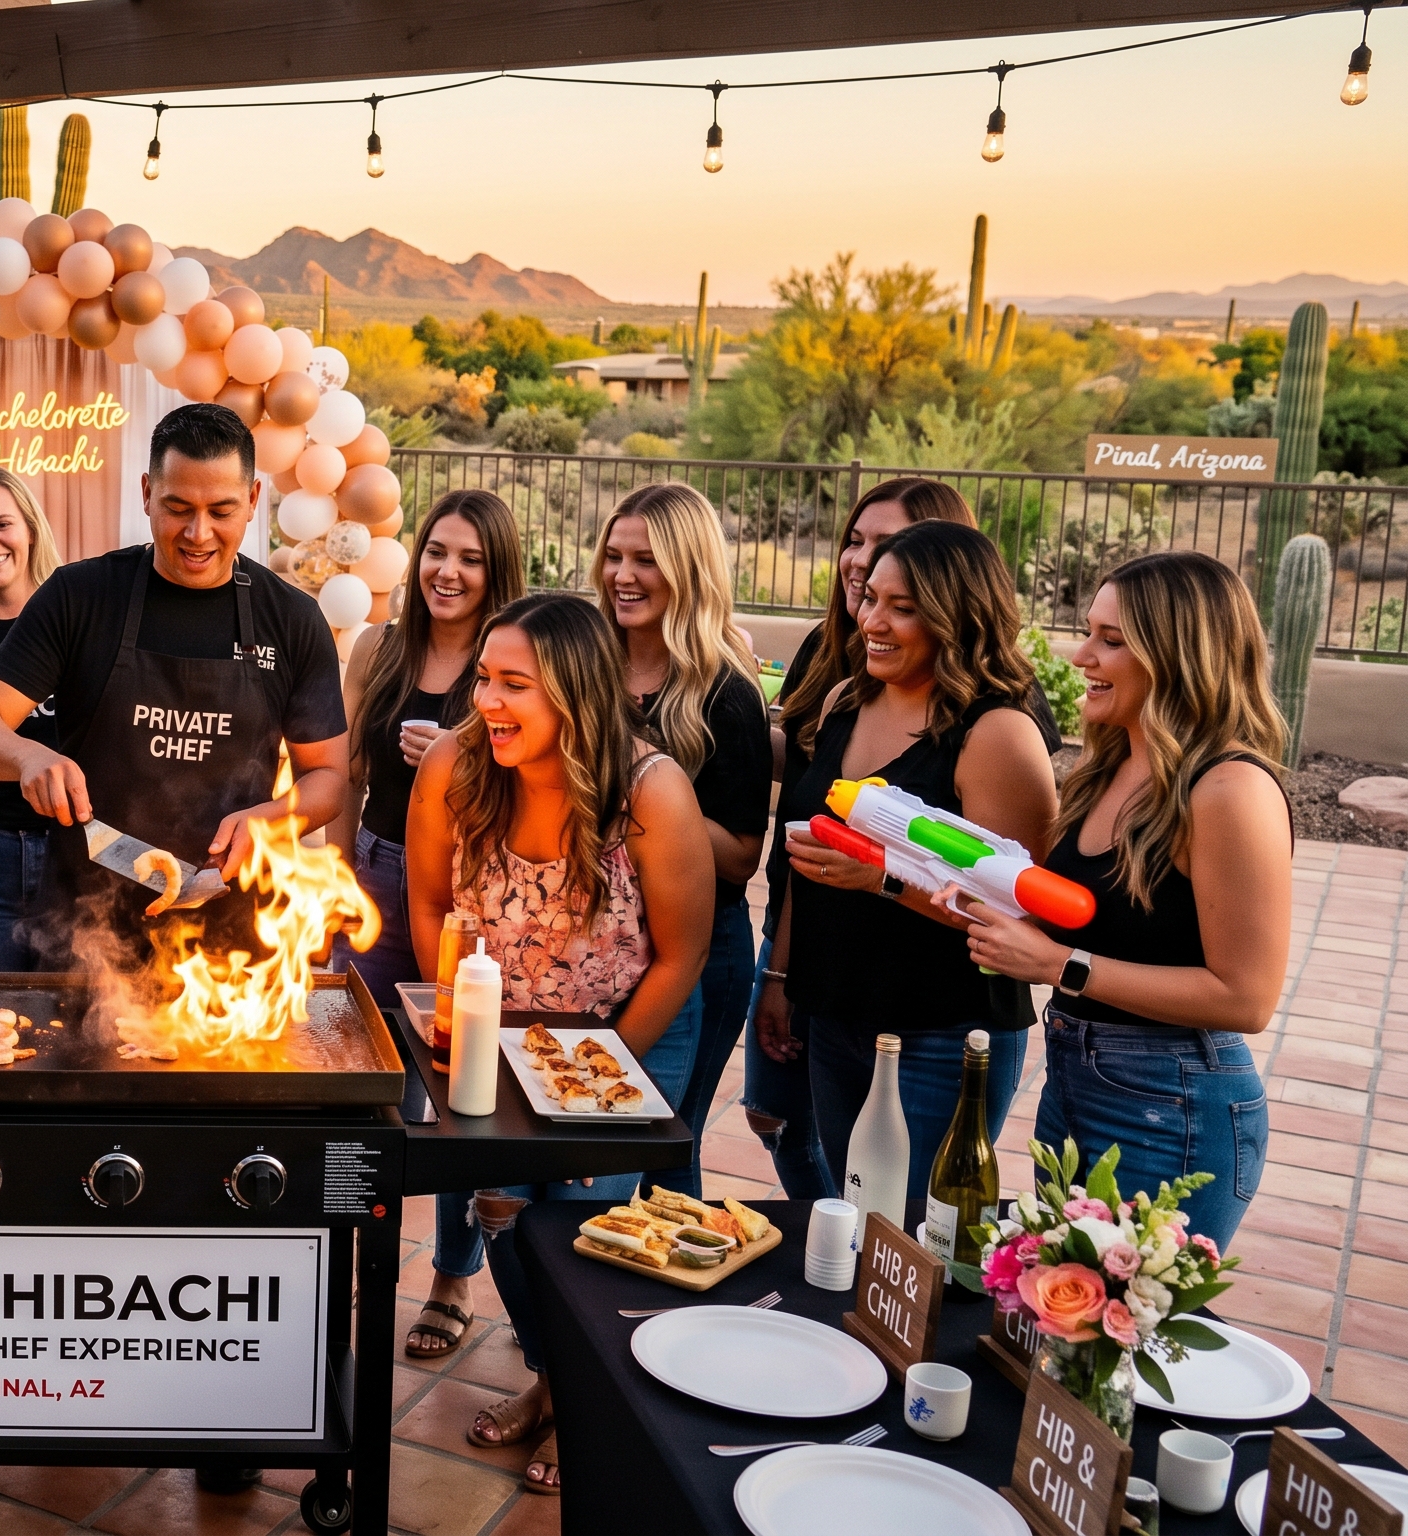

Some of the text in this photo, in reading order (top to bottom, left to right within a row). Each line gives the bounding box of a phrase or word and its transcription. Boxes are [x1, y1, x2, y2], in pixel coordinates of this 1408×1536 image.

[1094, 442, 1267, 479] Pinal, Arizona
[133, 704, 233, 735] PRIVATE
[149, 735, 213, 762] CHEF
[872, 1237, 903, 1287] HIB
[904, 1265, 919, 1303] &
[2, 1273, 281, 1322] HIBACHI
[867, 1282, 913, 1348] CHILL
[59, 1337, 260, 1362] EXPERIENCE
[69, 1379, 106, 1399] AZ
[1036, 1403, 1096, 1491] HIB &
[1029, 1456, 1086, 1536] CHILL
[1284, 1463, 1333, 1530] HIB
